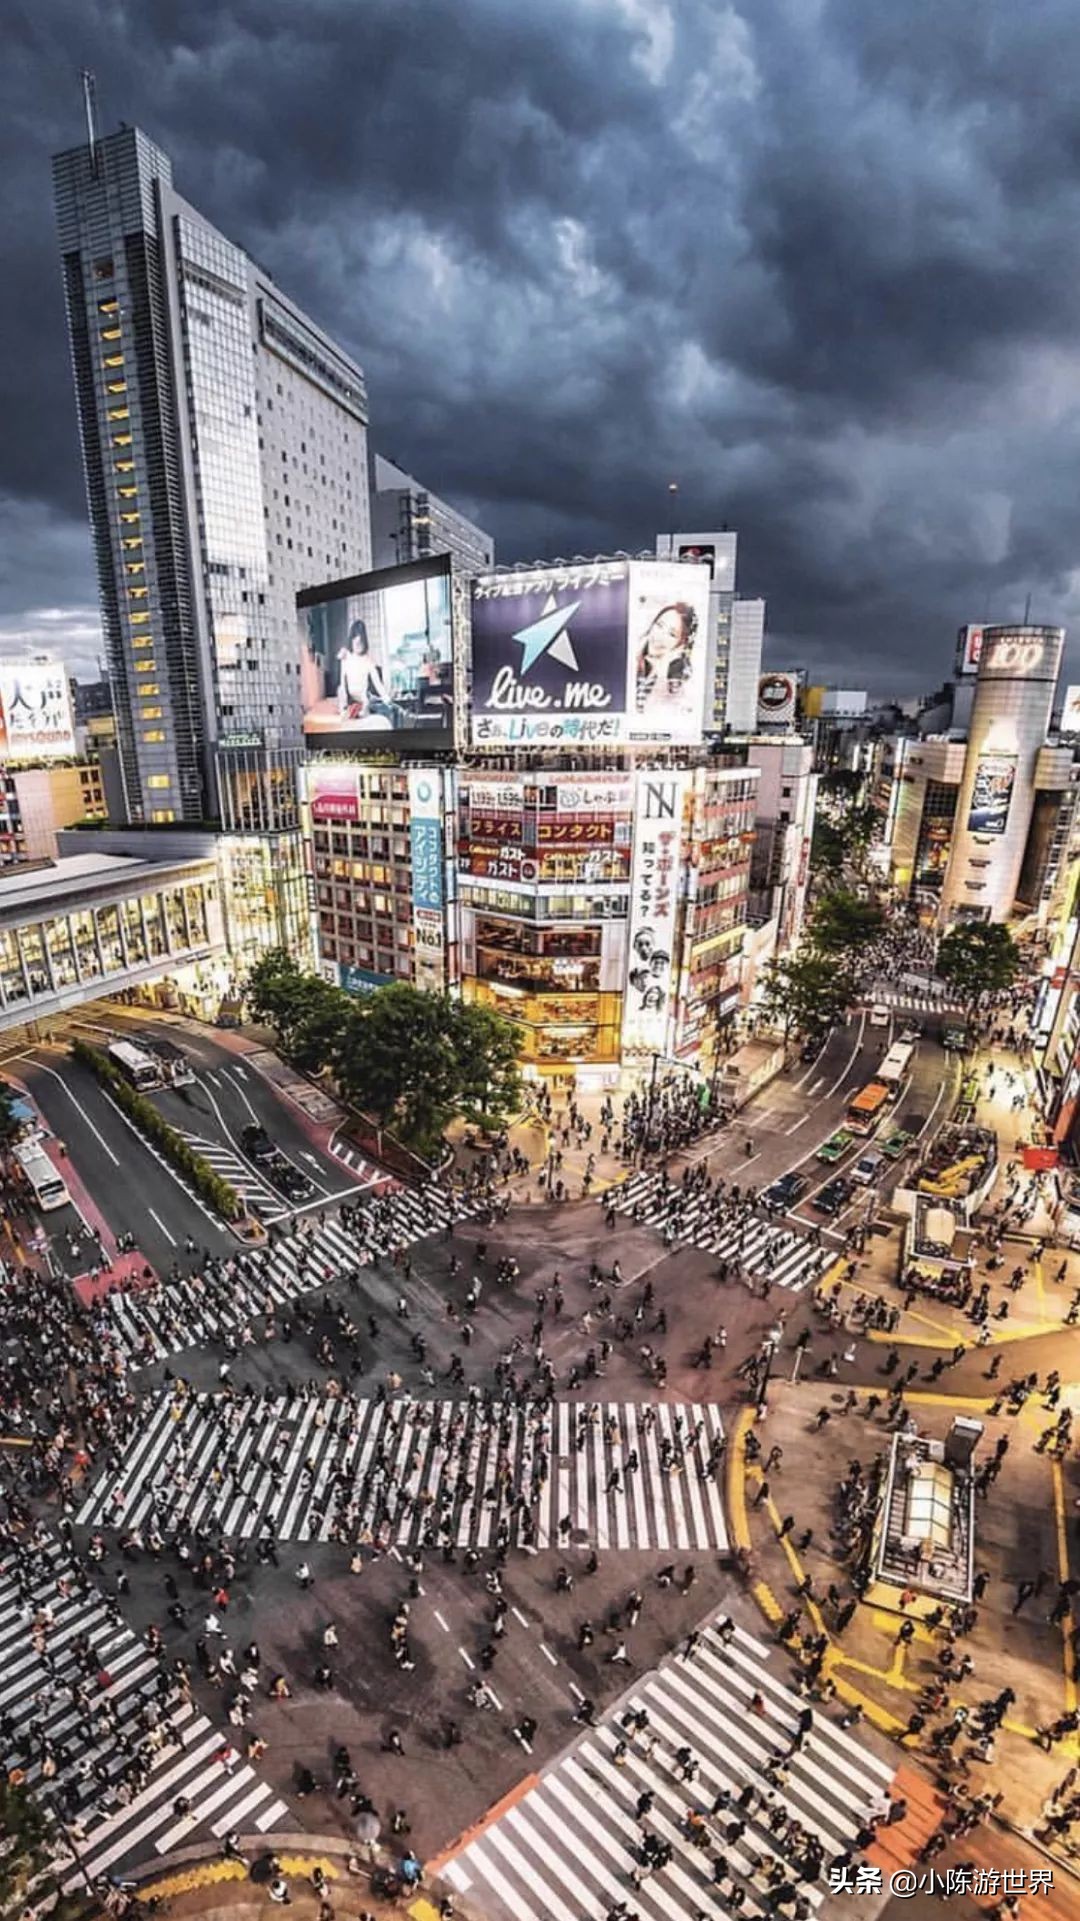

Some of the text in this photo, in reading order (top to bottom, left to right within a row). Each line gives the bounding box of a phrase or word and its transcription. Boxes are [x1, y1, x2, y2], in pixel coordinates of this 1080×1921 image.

[484, 665, 612, 709] live.me
[538, 824, 612, 839] コンタクト
[487, 860, 518, 878] ガスト
